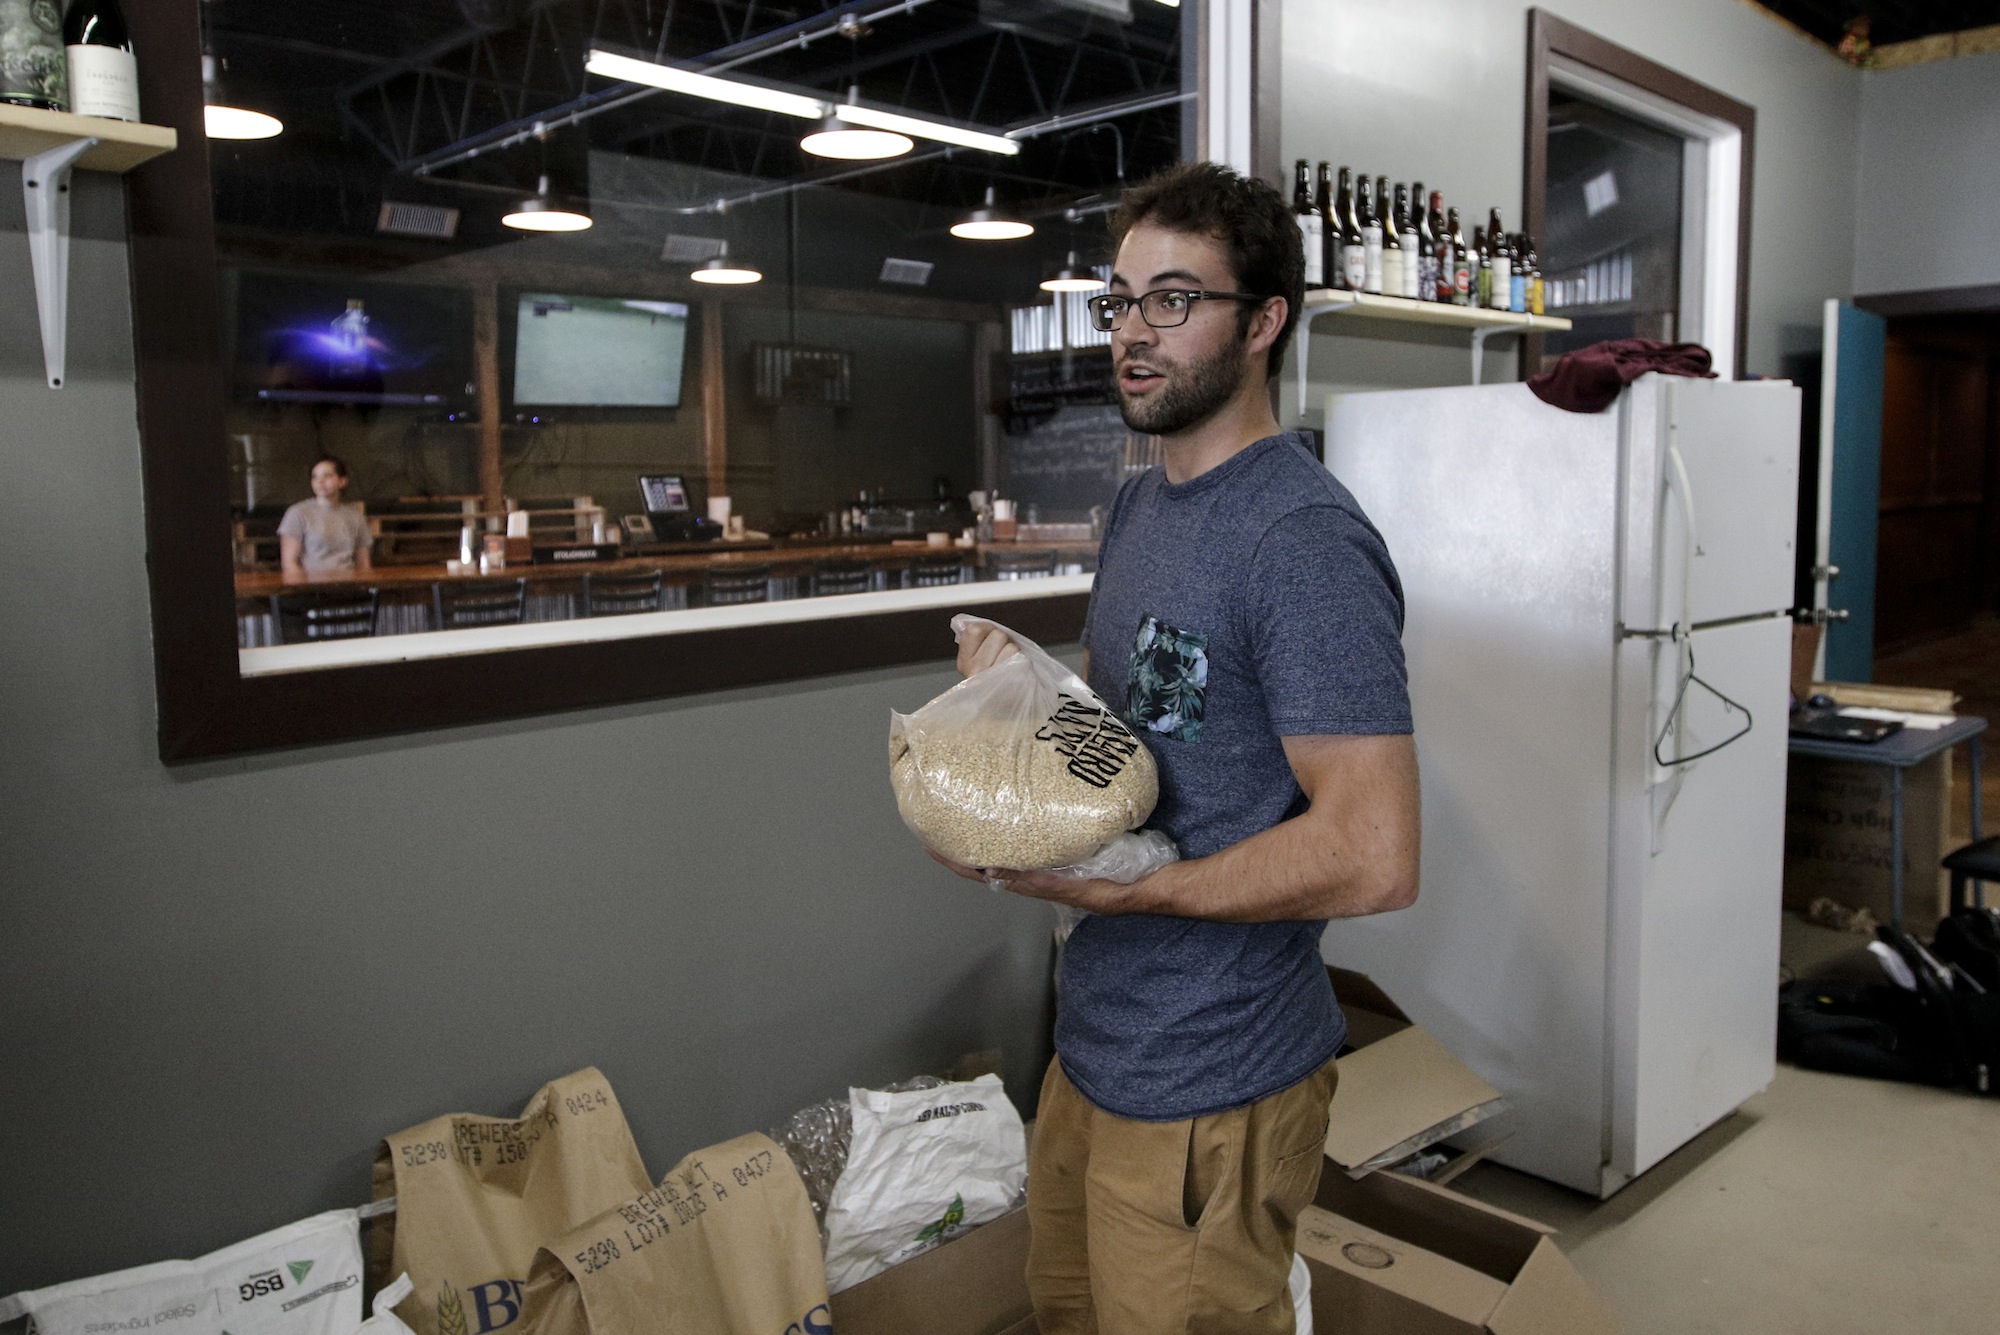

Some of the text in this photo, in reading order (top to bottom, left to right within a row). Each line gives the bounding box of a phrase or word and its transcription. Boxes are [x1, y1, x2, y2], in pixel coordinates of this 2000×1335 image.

[401, 1141, 447, 1167] 5298
[566, 1088, 608, 1116] 0424
[574, 1237, 621, 1275] 5298
[712, 1180, 729, 1202] A
[731, 1150, 772, 1187] 0437
[155, 1304, 196, 1325] Select
[239, 1275, 284, 1302] BSG
